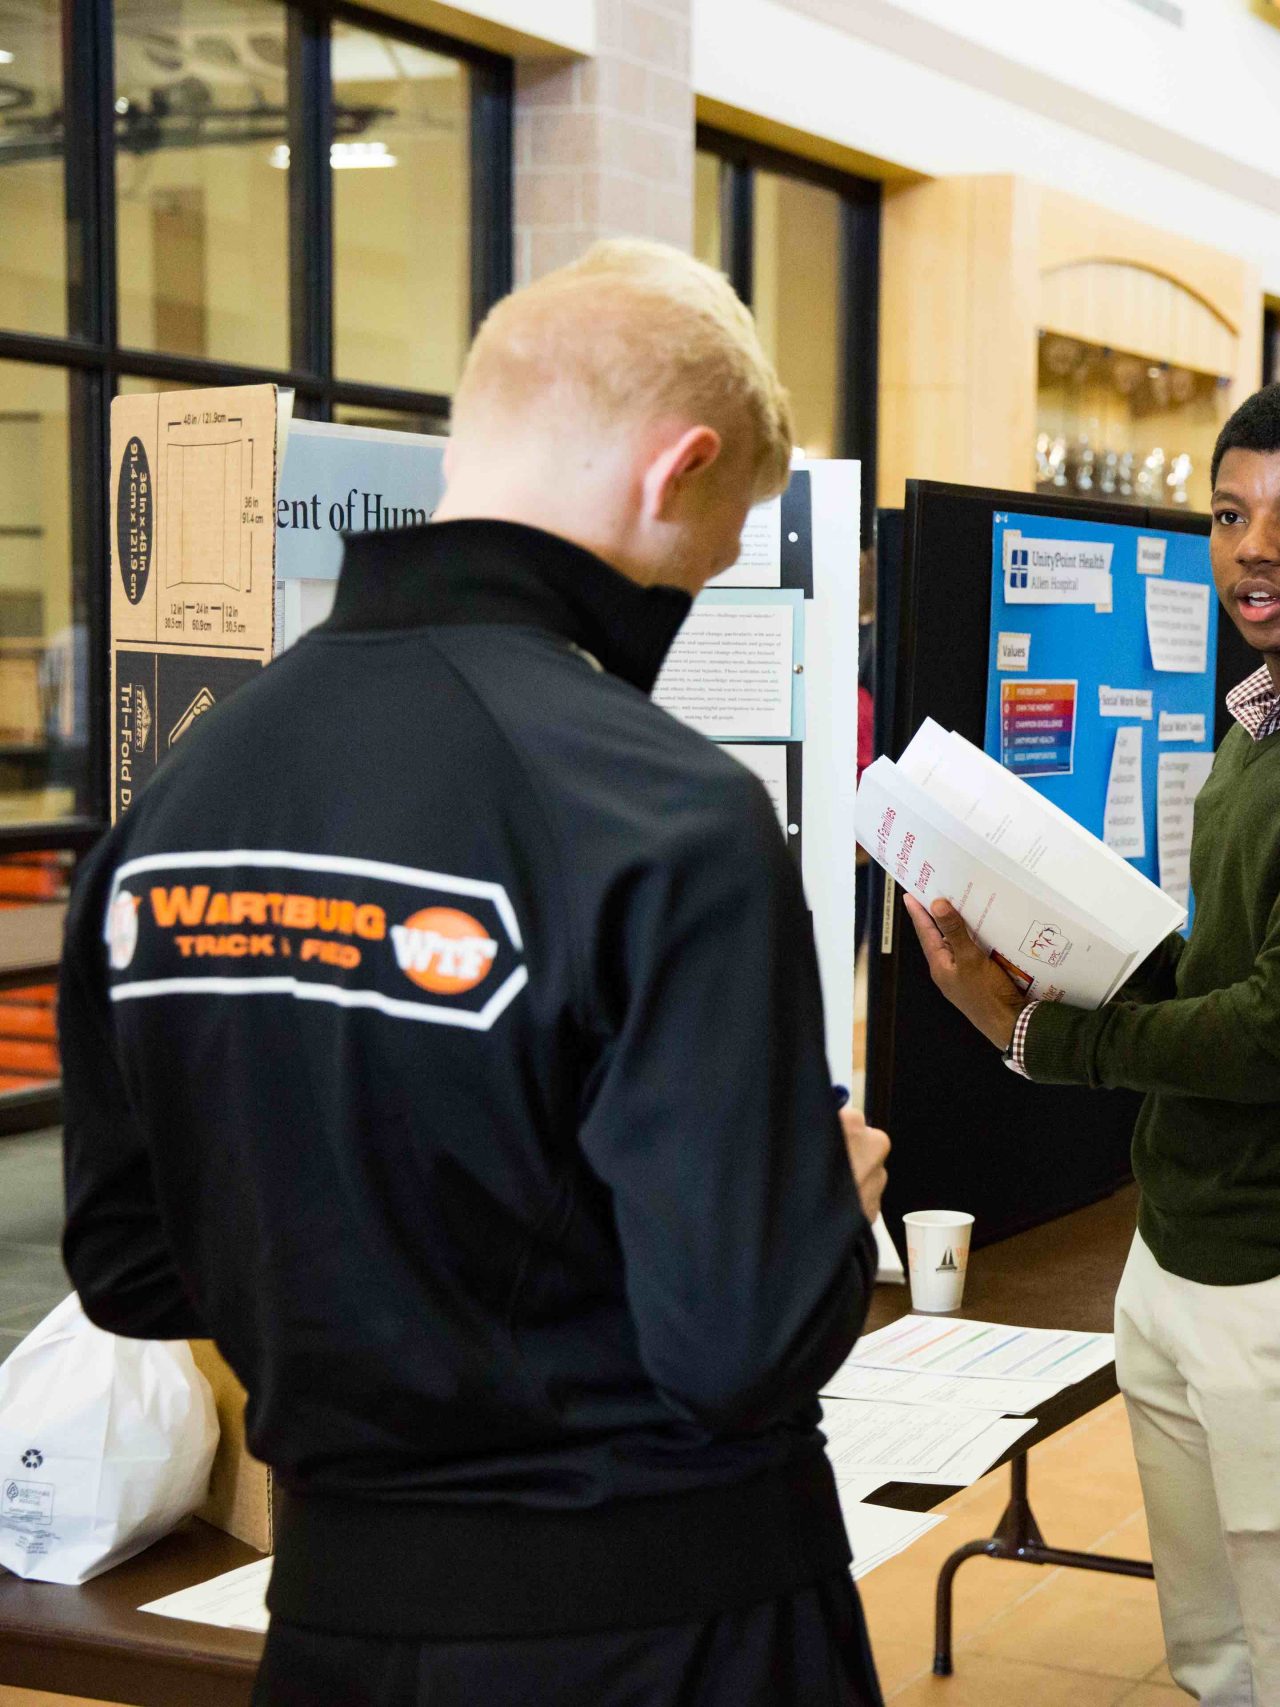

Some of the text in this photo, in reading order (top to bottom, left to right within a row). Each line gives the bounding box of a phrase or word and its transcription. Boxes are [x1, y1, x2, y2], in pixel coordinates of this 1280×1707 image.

[139, 472, 147, 494] 36
[130, 443, 138, 600] 91.4 cm x 121.9 cm
[139, 516, 146, 527] x
[329, 488, 358, 532] of
[361, 492, 437, 531] Hum
[139, 530, 147, 552] 48
[1032, 551, 1105, 571] UnityPoint Health
[1002, 644, 1026, 658] Values
[121, 682, 132, 782] Tri-Fold
[878, 806, 897, 841] Families
[896, 831, 916, 865] Services
[914, 860, 936, 893] Directory
